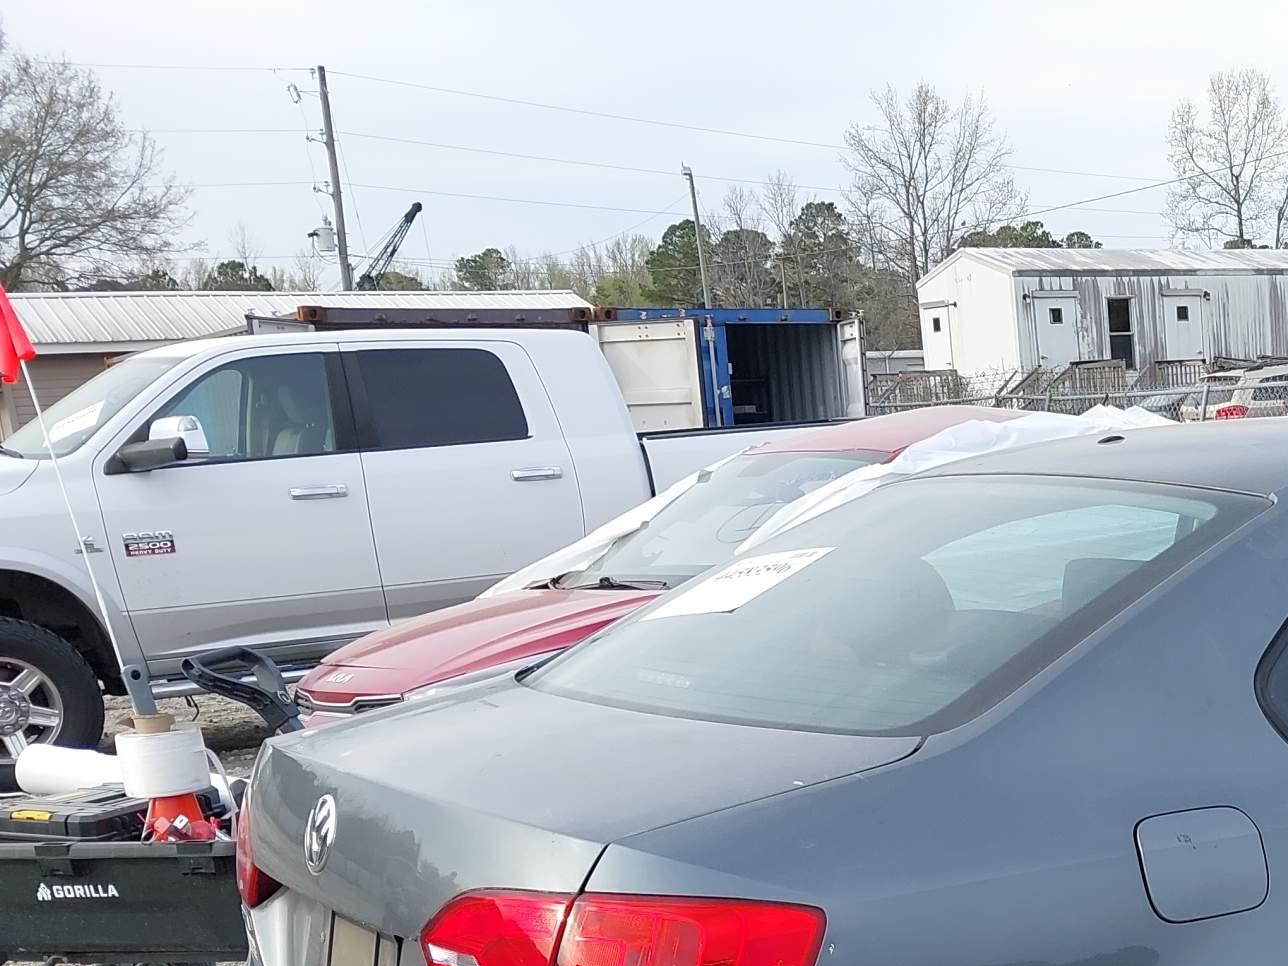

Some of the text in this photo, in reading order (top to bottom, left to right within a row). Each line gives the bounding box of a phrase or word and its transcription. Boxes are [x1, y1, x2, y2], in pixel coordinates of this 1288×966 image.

[122, 530, 173, 543] RAM
[128, 541, 171, 550] 2500
[52, 883, 119, 899] GORILLA
